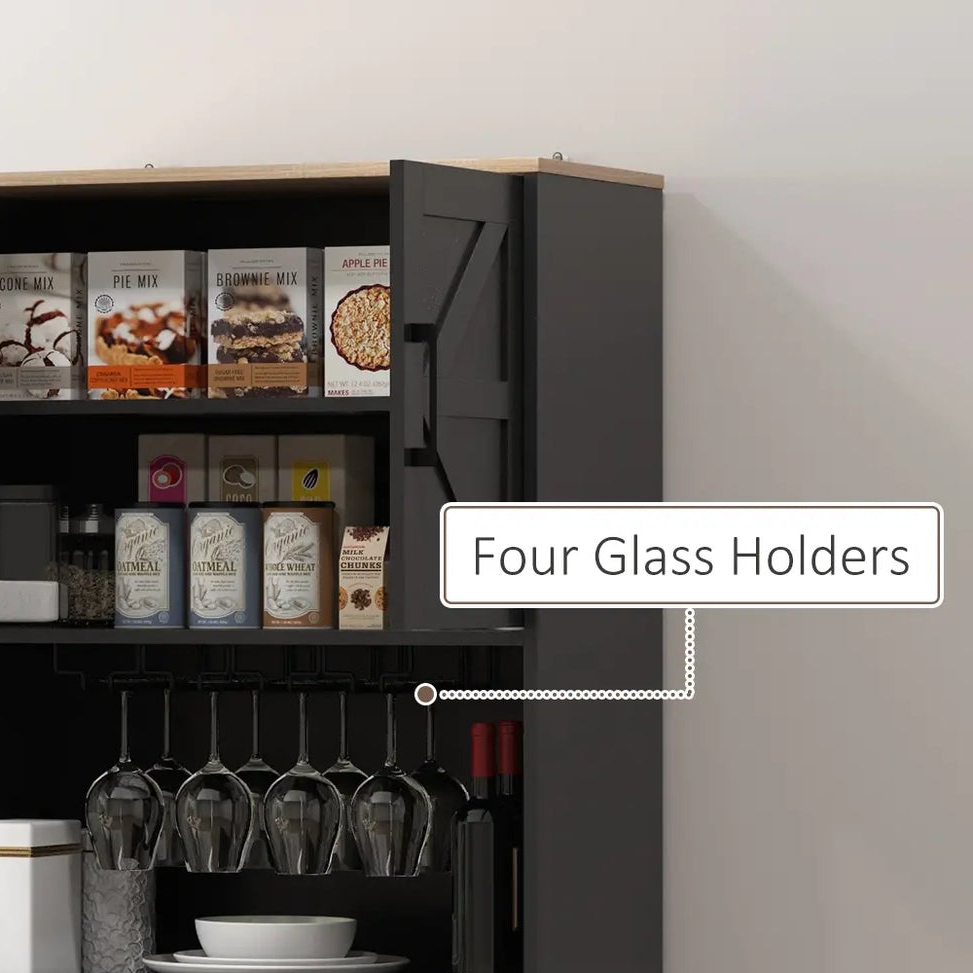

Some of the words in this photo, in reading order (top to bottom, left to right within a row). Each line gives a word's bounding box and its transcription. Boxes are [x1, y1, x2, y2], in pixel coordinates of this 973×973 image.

[342, 259, 371, 269] APPLE
[373, 258, 388, 268] PIE
[34, 276, 54, 290] MIX
[113, 275, 131, 289] PIE
[137, 274, 158, 288] MIX
[216, 272, 270, 287] BROWNIE
[277, 272, 298, 286] MIX
[117, 561, 161, 572] OATMEAL
[193, 560, 237, 572] OATMEAL
[287, 562, 315, 572] WHEAT
